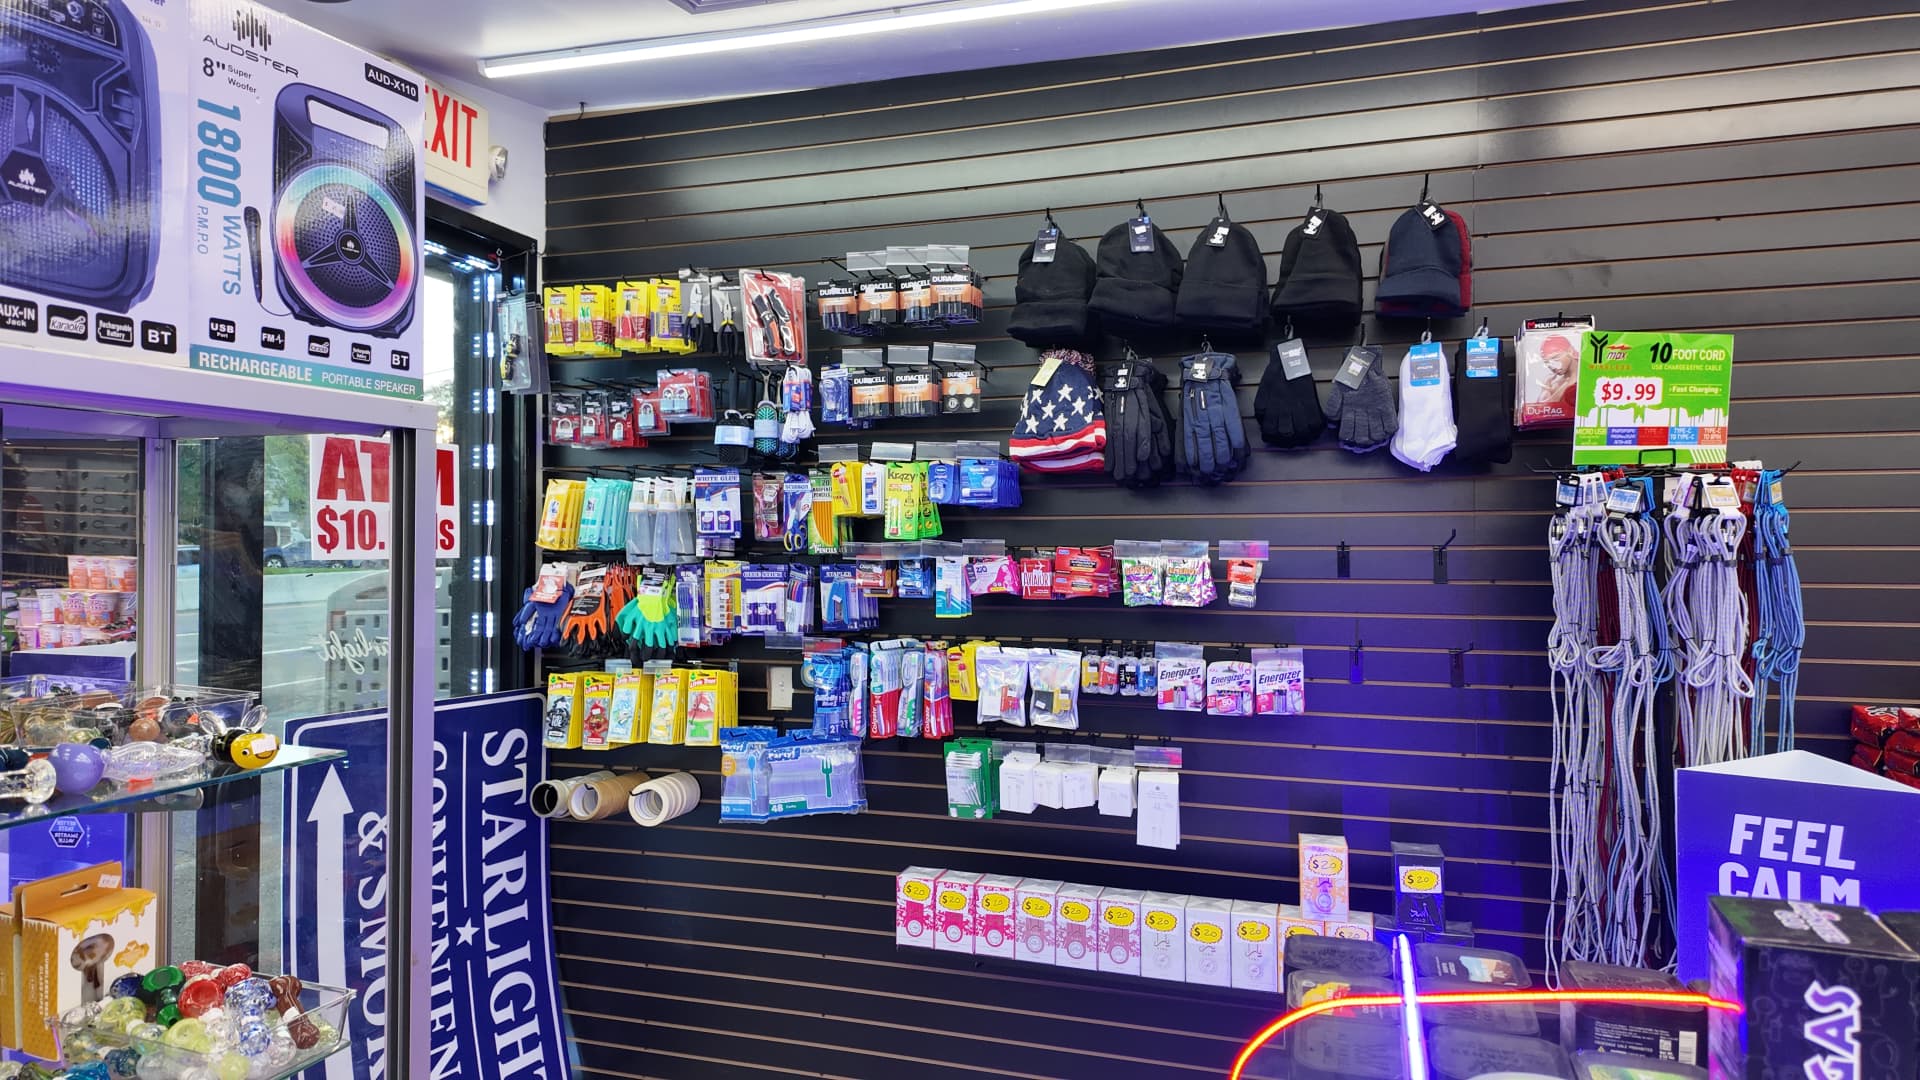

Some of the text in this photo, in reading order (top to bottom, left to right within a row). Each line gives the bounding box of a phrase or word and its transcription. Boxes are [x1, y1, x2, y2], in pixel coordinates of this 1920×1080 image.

[203, 34, 299, 78] AUDSTER
[203, 57, 252, 79] 8" Super
[228, 77, 257, 93] Woofer
[368, 68, 417, 98] AUD-X110
[424, 84, 478, 168] XIT
[197, 98, 242, 295] 1800 WATTS
[6, 318, 26, 327] Jack
[51, 319, 84, 333] Karaoke
[210, 322, 234, 334] USB
[106, 330, 126, 340] Battery
[148, 329, 171, 345] BT
[392, 354, 408, 367] BT
[1650, 342, 1726, 364] 10 FOOT CORD
[199, 351, 416, 395] RECHARGEABLE PORTABLE SPEAKER
[1601, 381, 1656, 403] $9.99
[1672, 385, 1719, 394] Fast Charging
[1160, 666, 1200, 680] Energizer
[1211, 672, 1245, 685] Energizer
[1259, 669, 1301, 684] Energizer
[771, 804, 784, 813] 48
[1729, 813, 1856, 871] FEEL
[1718, 861, 1861, 907] CALM
